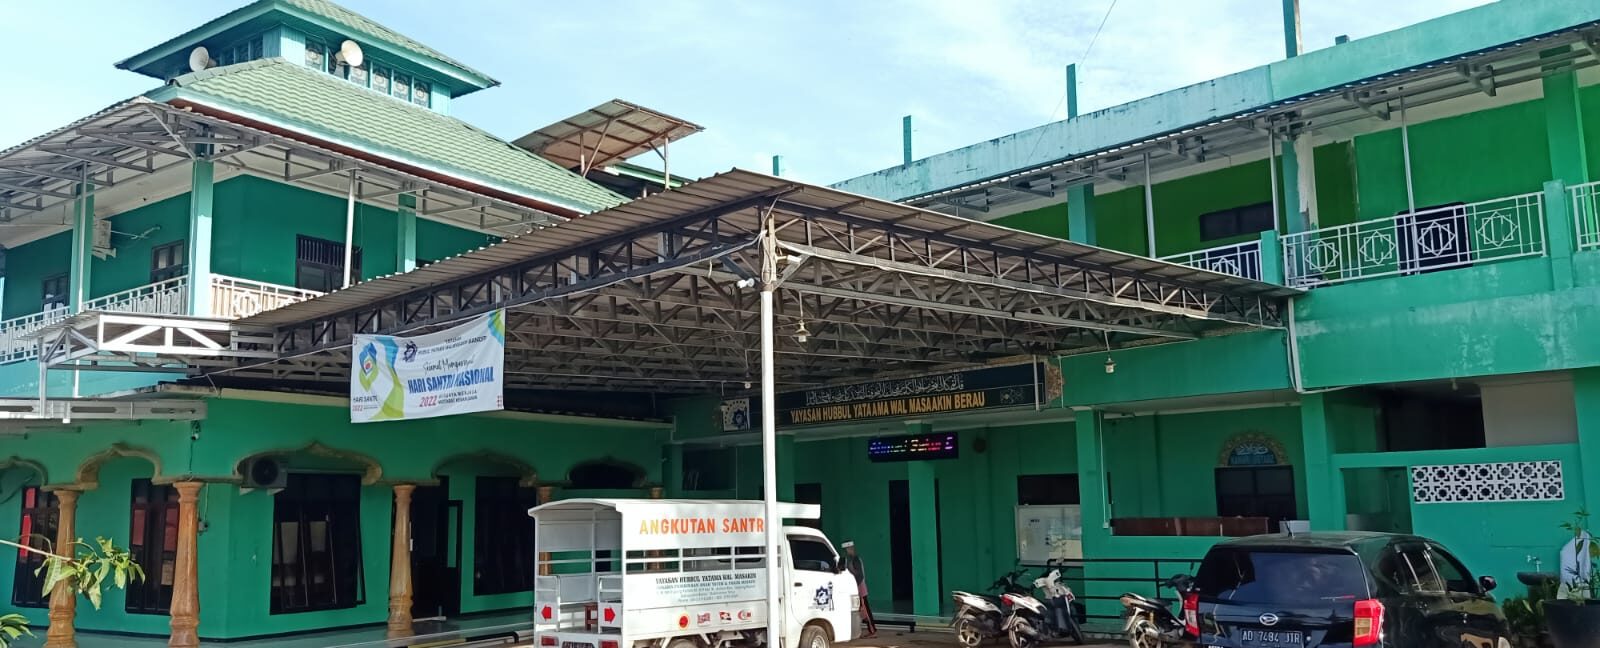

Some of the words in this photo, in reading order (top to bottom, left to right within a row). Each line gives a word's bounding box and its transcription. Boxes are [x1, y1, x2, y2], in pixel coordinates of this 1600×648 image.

[408, 378, 426, 394] HARI
[454, 366, 494, 387] NASIONAL
[419, 394, 437, 407] 2022
[790, 408, 822, 424] YAYASAN
[822, 406, 851, 421] HUBBUL
[853, 402, 889, 419] YATAAMA
[890, 400, 908, 415] WAL
[909, 395, 951, 413] MASAAKIN
[954, 391, 985, 409] BERAU
[639, 518, 715, 534] ANGKUTAN
[722, 517, 764, 533] SANTR
[1242, 630, 1253, 641] AD
